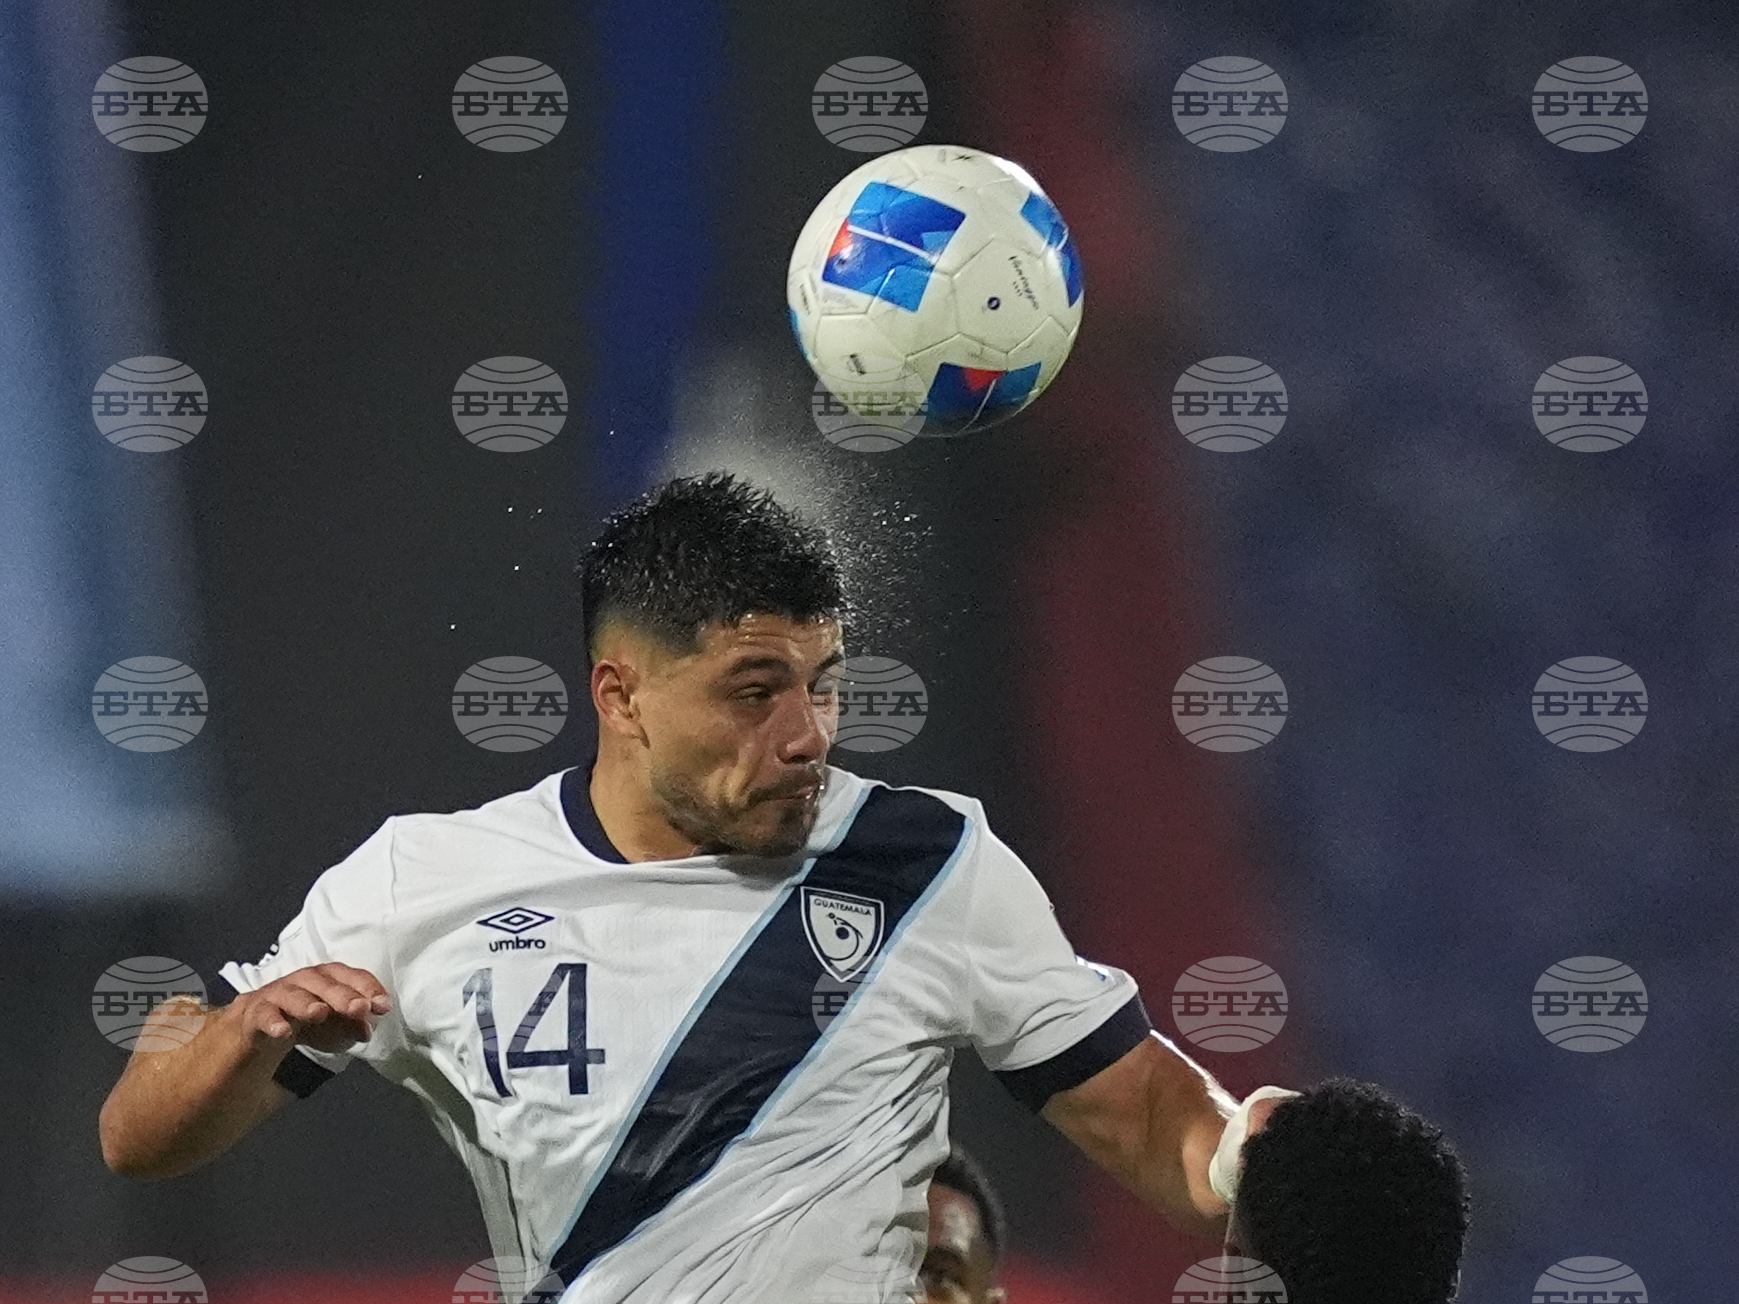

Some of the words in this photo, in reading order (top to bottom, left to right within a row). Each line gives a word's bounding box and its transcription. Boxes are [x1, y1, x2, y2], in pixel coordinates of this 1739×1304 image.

[813, 898, 873, 916] GUATEMALA
[489, 936, 546, 952] umbro
[462, 963, 606, 1098] 14
